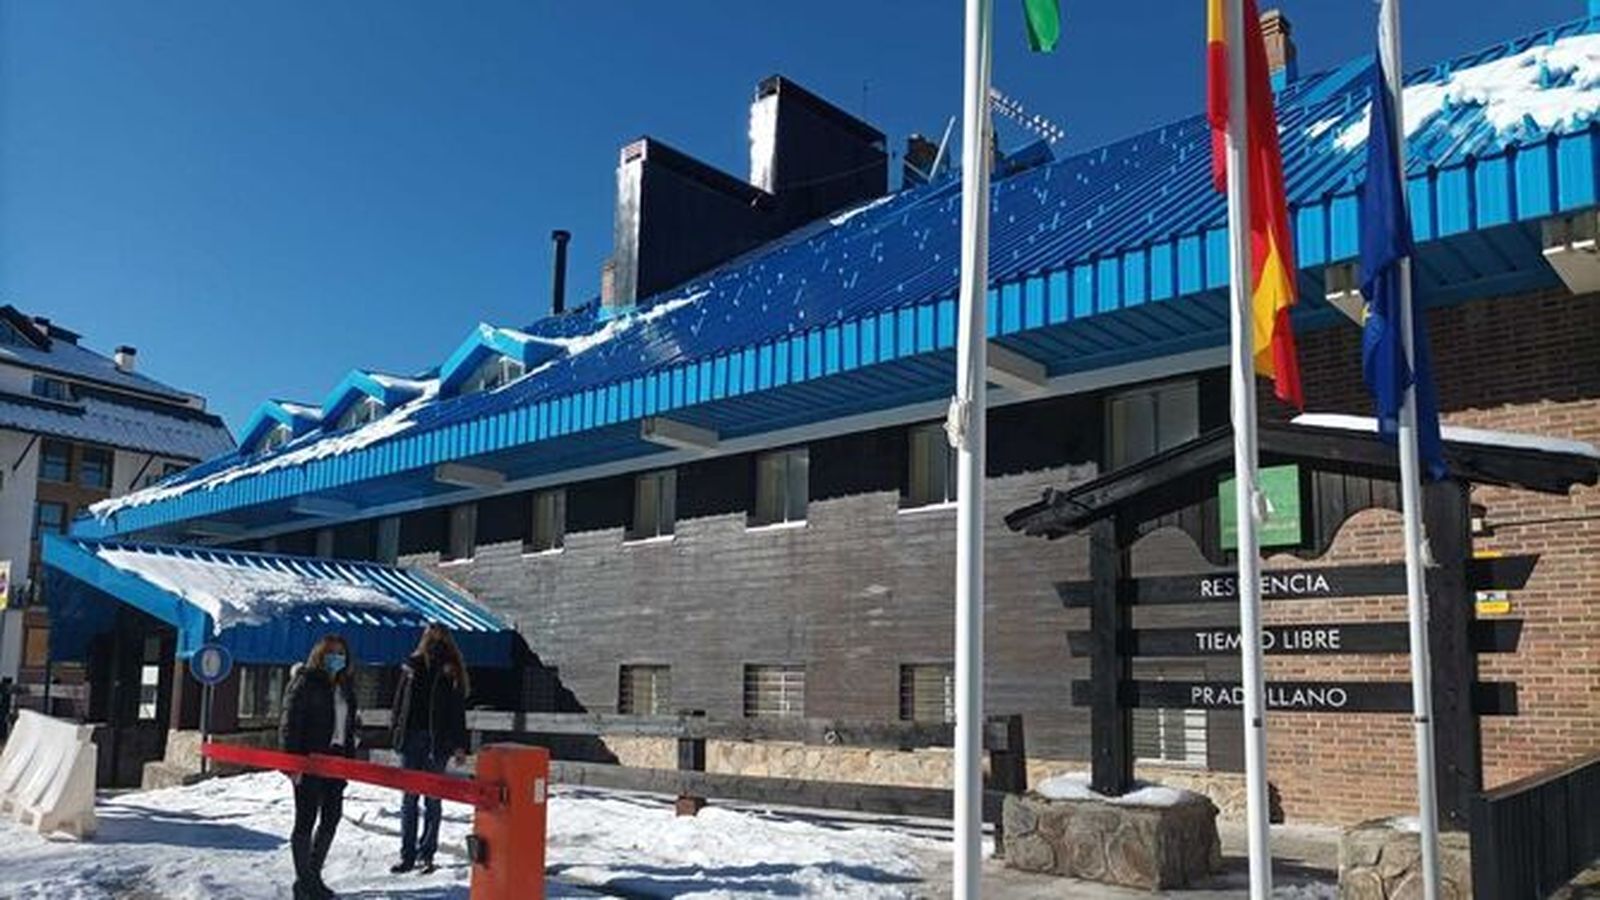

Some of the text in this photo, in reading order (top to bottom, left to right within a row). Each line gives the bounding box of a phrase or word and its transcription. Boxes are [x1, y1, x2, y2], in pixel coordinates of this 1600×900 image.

[1200, 574, 1330, 597] RESENCIA
[1196, 629, 1341, 650] TIEMO LIBRE
[1191, 686, 1347, 707] PRADLLANO
